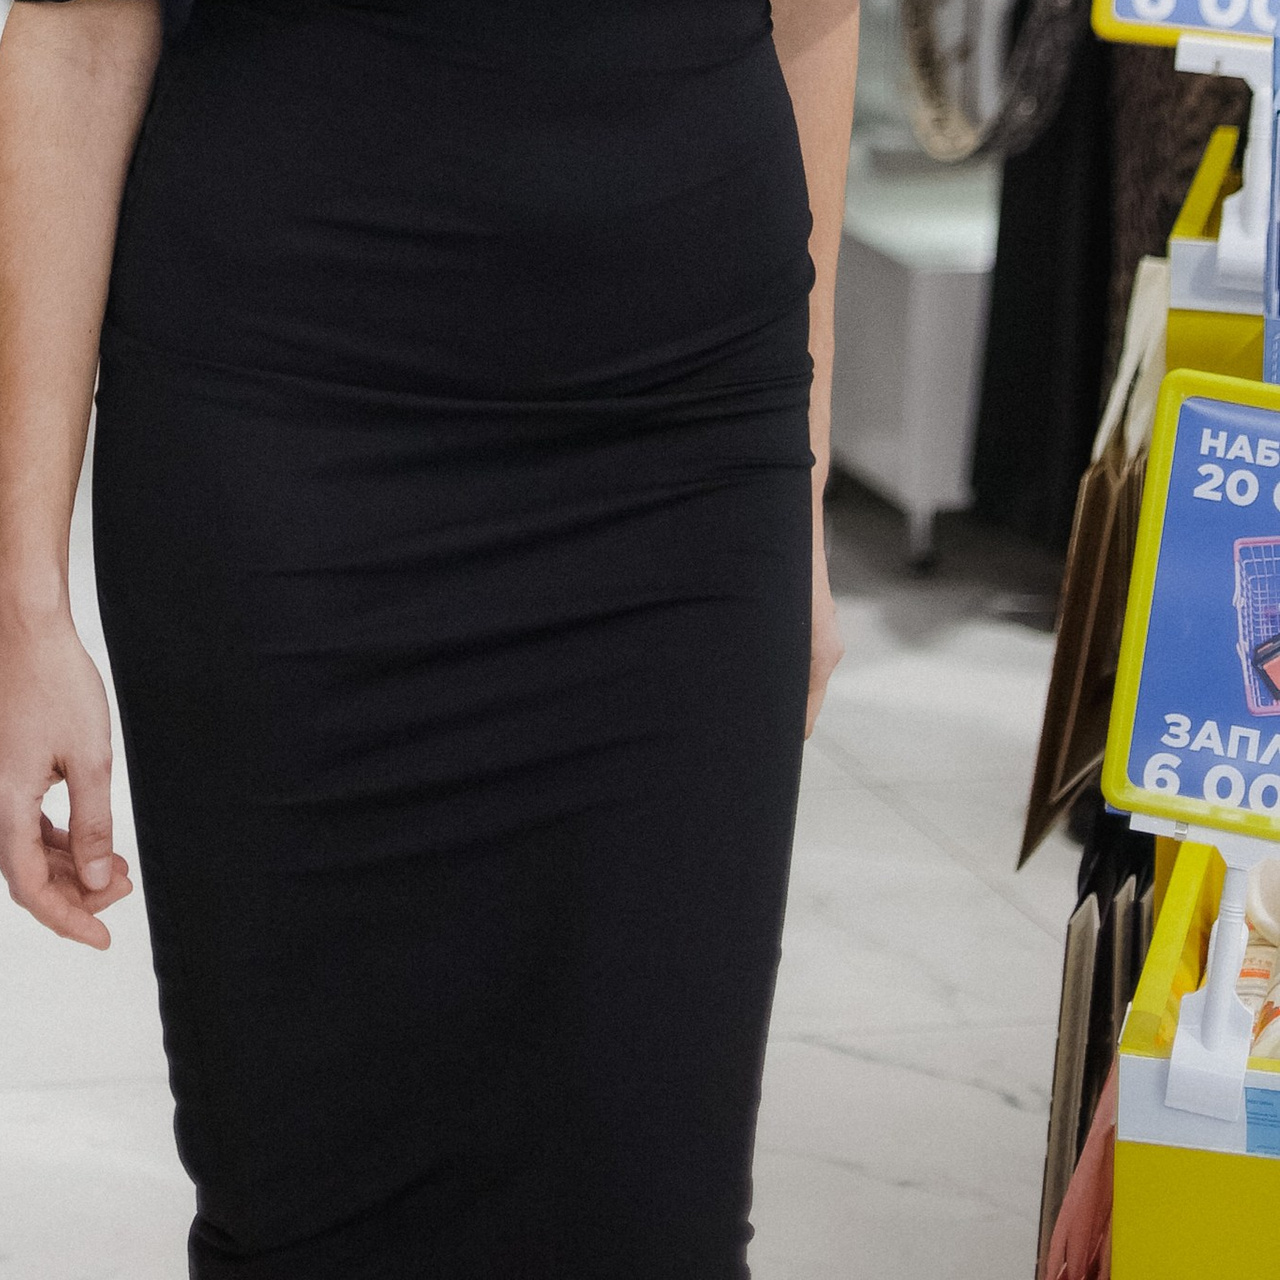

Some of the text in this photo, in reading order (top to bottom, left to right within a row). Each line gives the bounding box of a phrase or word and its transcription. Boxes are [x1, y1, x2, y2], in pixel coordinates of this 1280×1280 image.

[1200, 428, 1280, 468] НАБ
[1193, 463, 1260, 507] 20
[1143, 752, 1182, 797] 6
